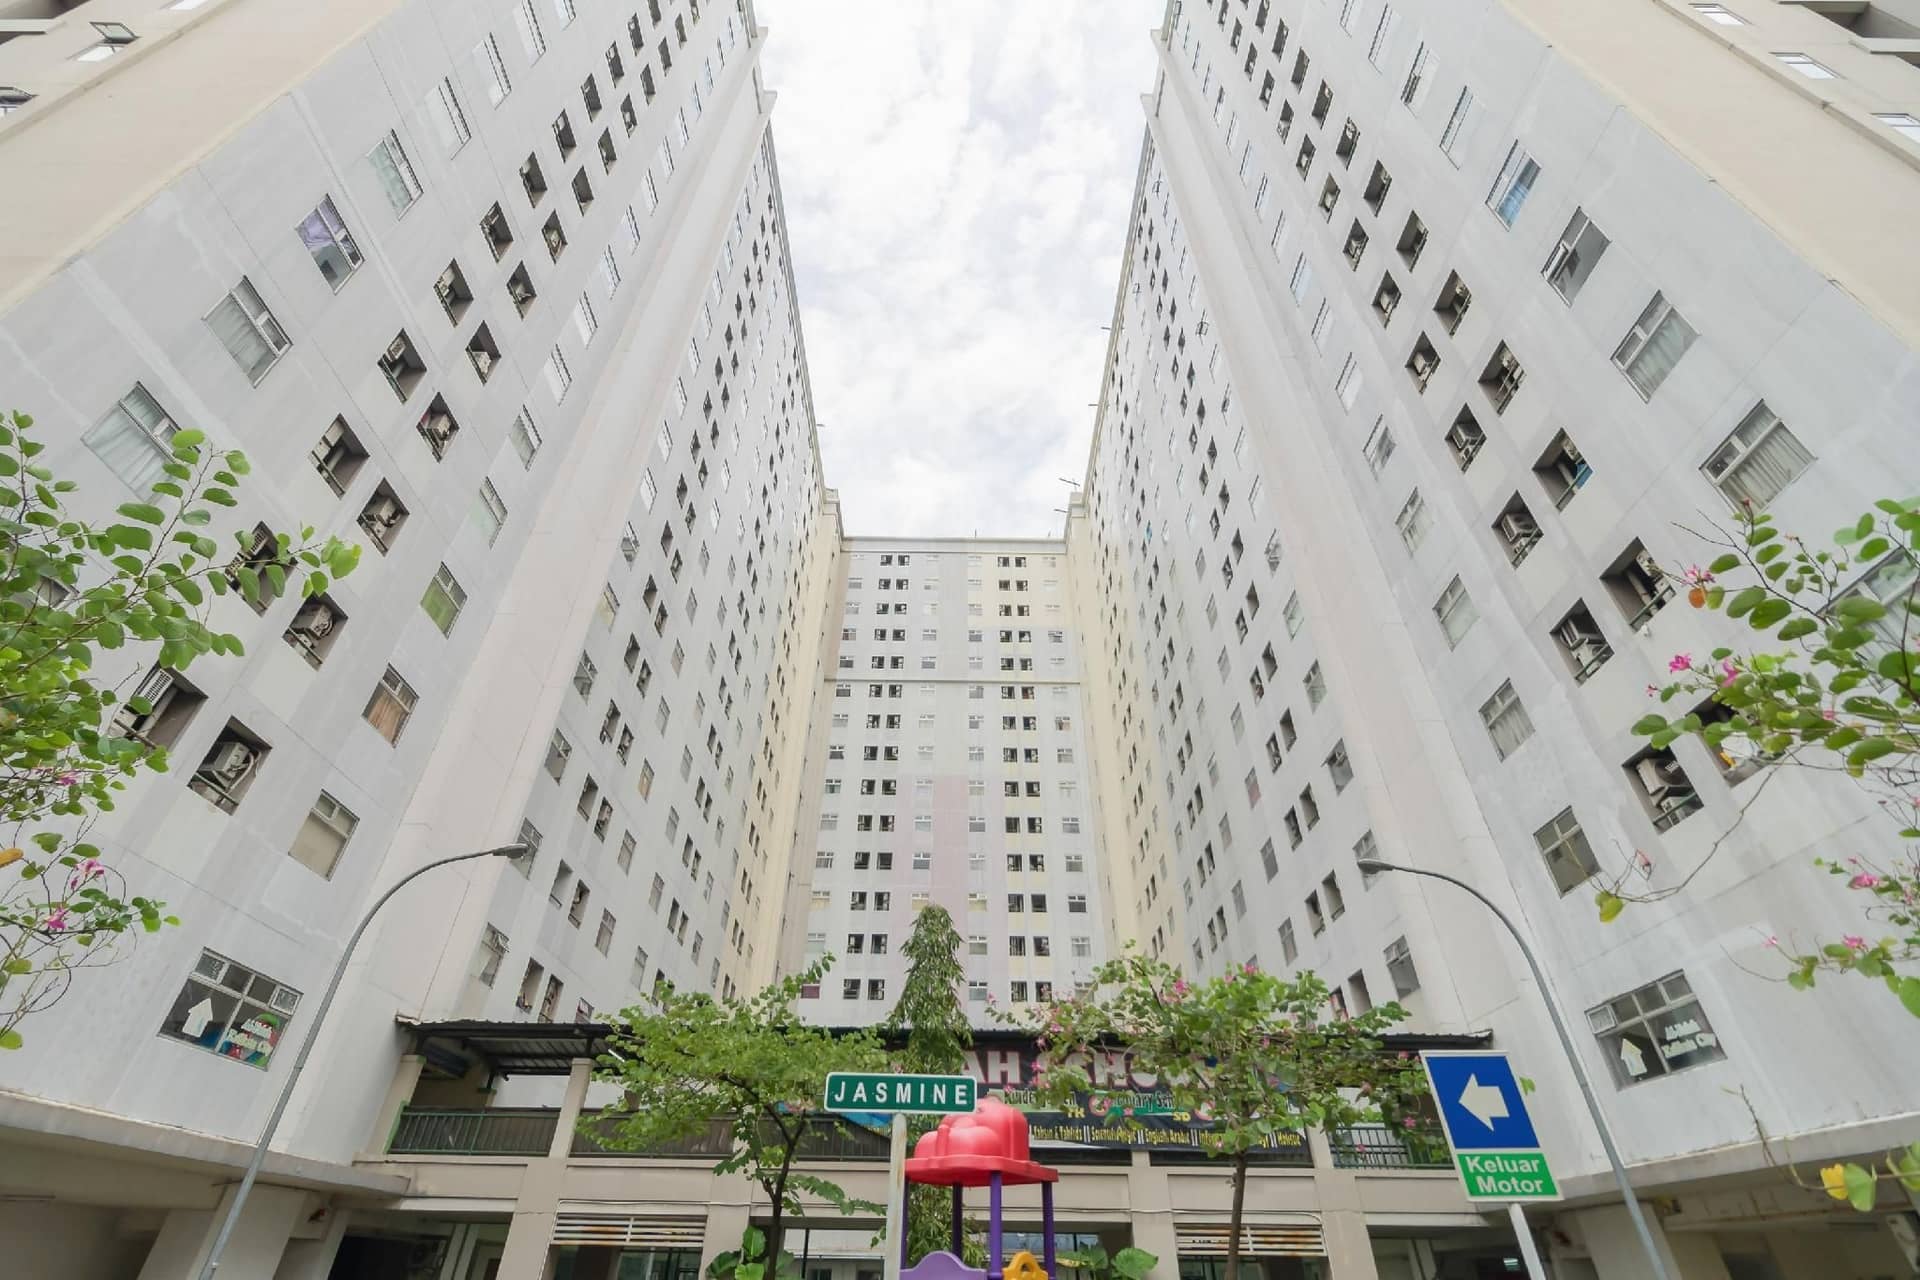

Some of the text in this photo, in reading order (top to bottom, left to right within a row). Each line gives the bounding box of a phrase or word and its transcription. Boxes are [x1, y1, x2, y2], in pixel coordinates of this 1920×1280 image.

[834, 1081, 968, 1105] JASMINE
[1465, 1156, 1540, 1173] Keluar
[1476, 1175, 1543, 1193] Motor
